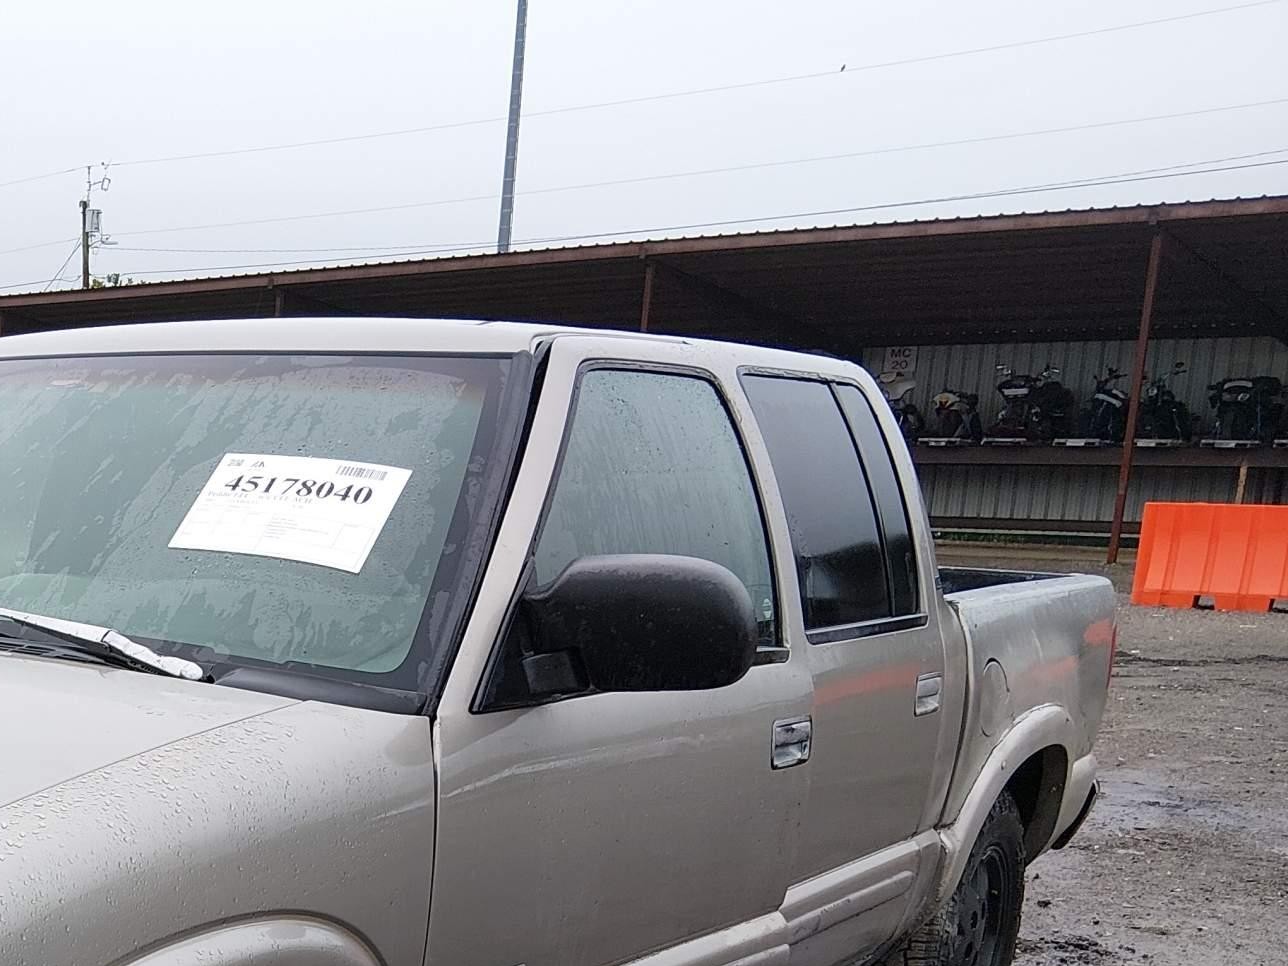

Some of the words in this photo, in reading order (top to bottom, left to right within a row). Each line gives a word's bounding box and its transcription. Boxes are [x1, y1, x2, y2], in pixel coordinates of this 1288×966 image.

[890, 347, 912, 358] MC
[891, 359, 909, 370] 20
[224, 474, 373, 504] 45178040
